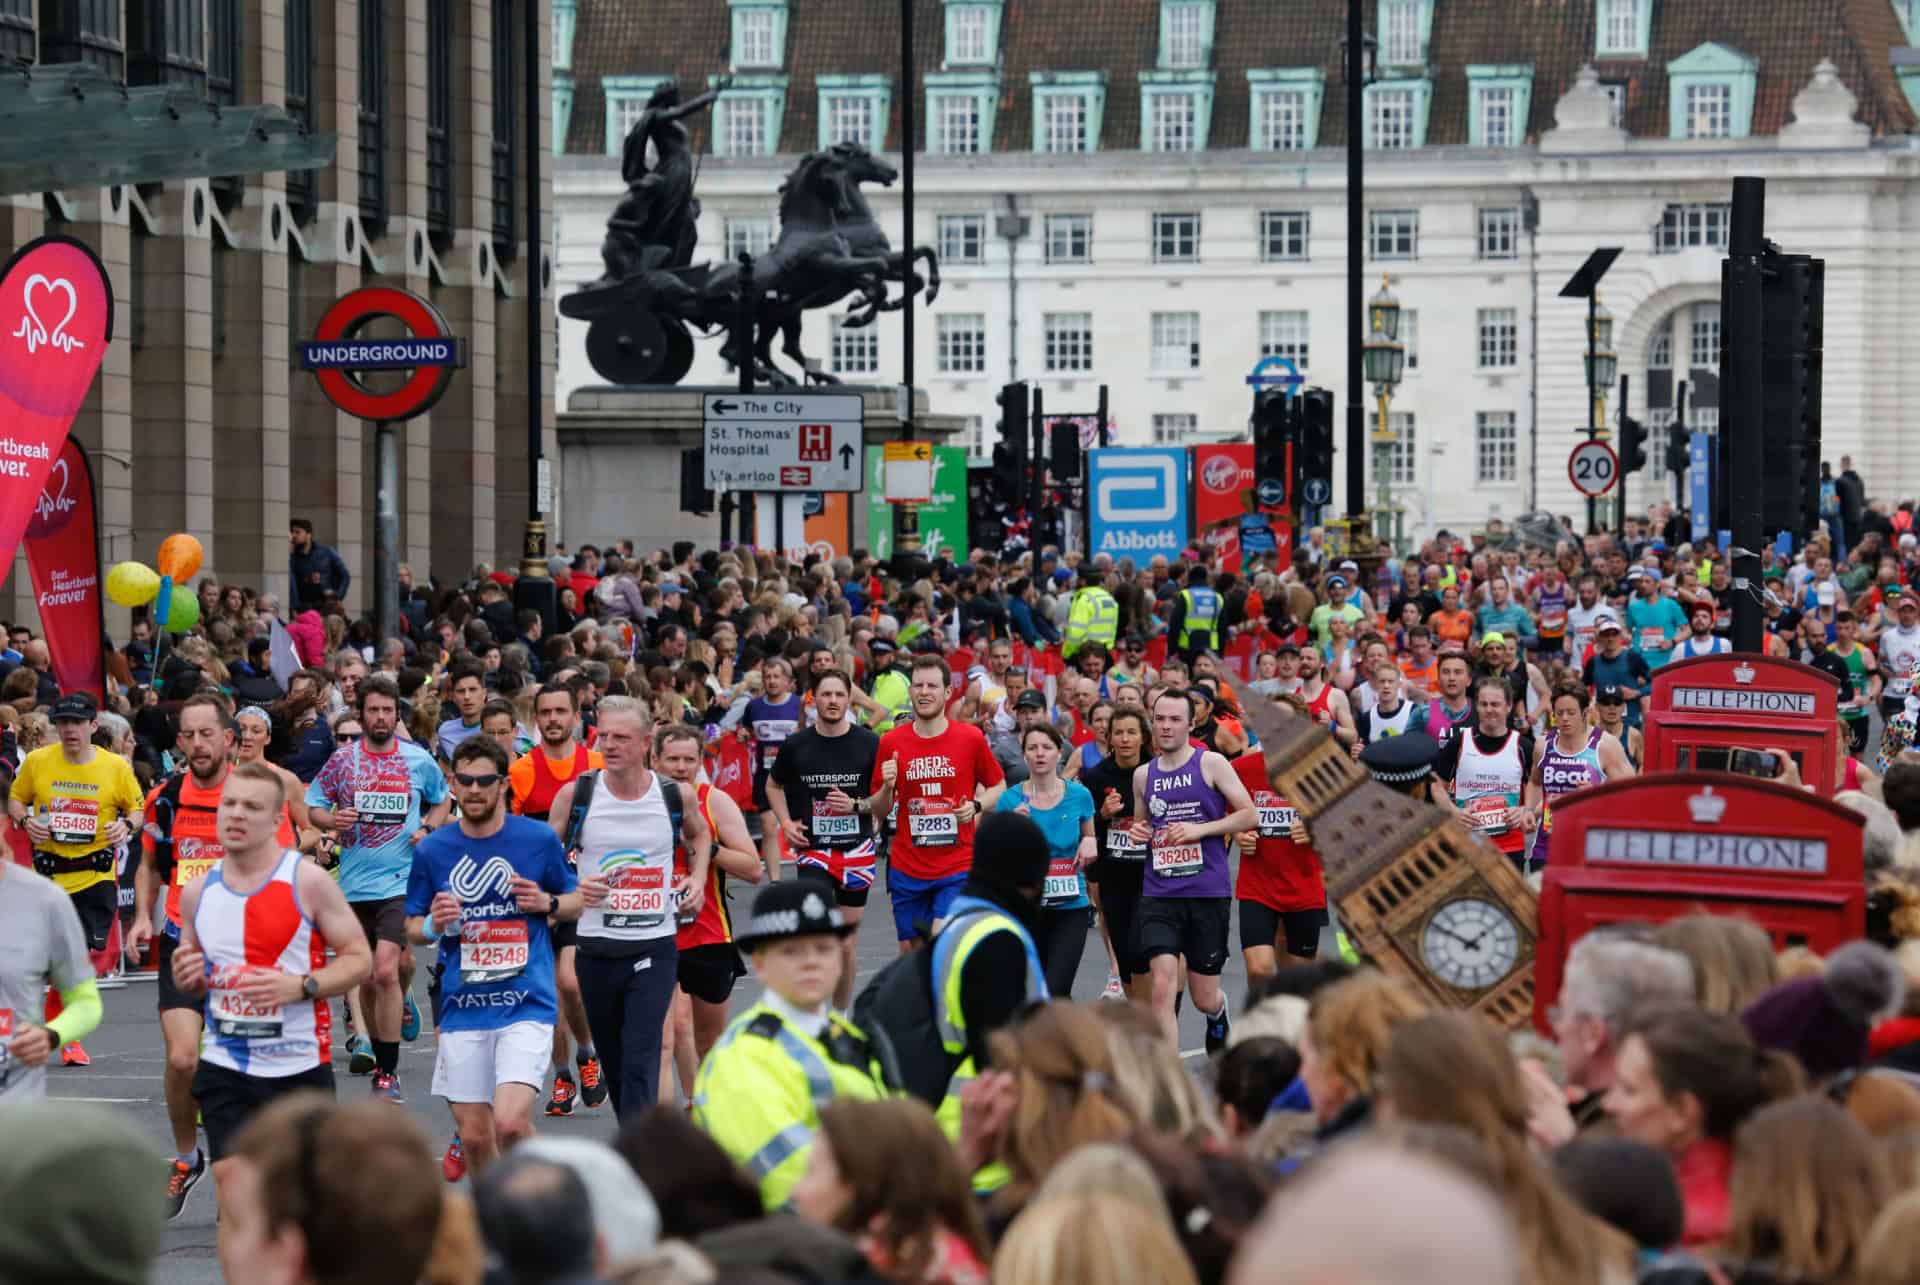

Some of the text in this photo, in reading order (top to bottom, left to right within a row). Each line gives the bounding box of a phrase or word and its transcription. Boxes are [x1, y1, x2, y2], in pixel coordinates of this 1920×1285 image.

[308, 344, 448, 362] UNDERGROUND
[743, 401, 803, 415] The City
[711, 427, 731, 440] St.
[805, 426, 825, 450] H
[710, 443, 770, 457] Hospital
[801, 451, 828, 461] A&E
[710, 469, 776, 482] aerloo
[1576, 456, 1612, 480] 20
[1100, 529, 1177, 549] Abbott
[40, 589, 86, 606] Forever
[1678, 689, 1810, 713] TELEPHONE
[916, 755, 941, 770] RED
[906, 766, 956, 781] RUNNERS
[1543, 766, 1592, 785] Beat
[51, 780, 99, 791] ANDREW
[920, 782, 942, 796] TIM
[1153, 773, 1193, 792] EWAN
[361, 794, 406, 810] 27350
[54, 815, 96, 831] 55488
[819, 818, 857, 833] 57954
[917, 817, 952, 832] 5283
[1112, 832, 1132, 848] 70
[1159, 847, 1200, 865] 36204
[1598, 831, 1814, 869] TELEPHONE
[610, 891, 661, 911] 35260
[470, 946, 527, 967] 42548
[453, 989, 529, 1009] YATESY
